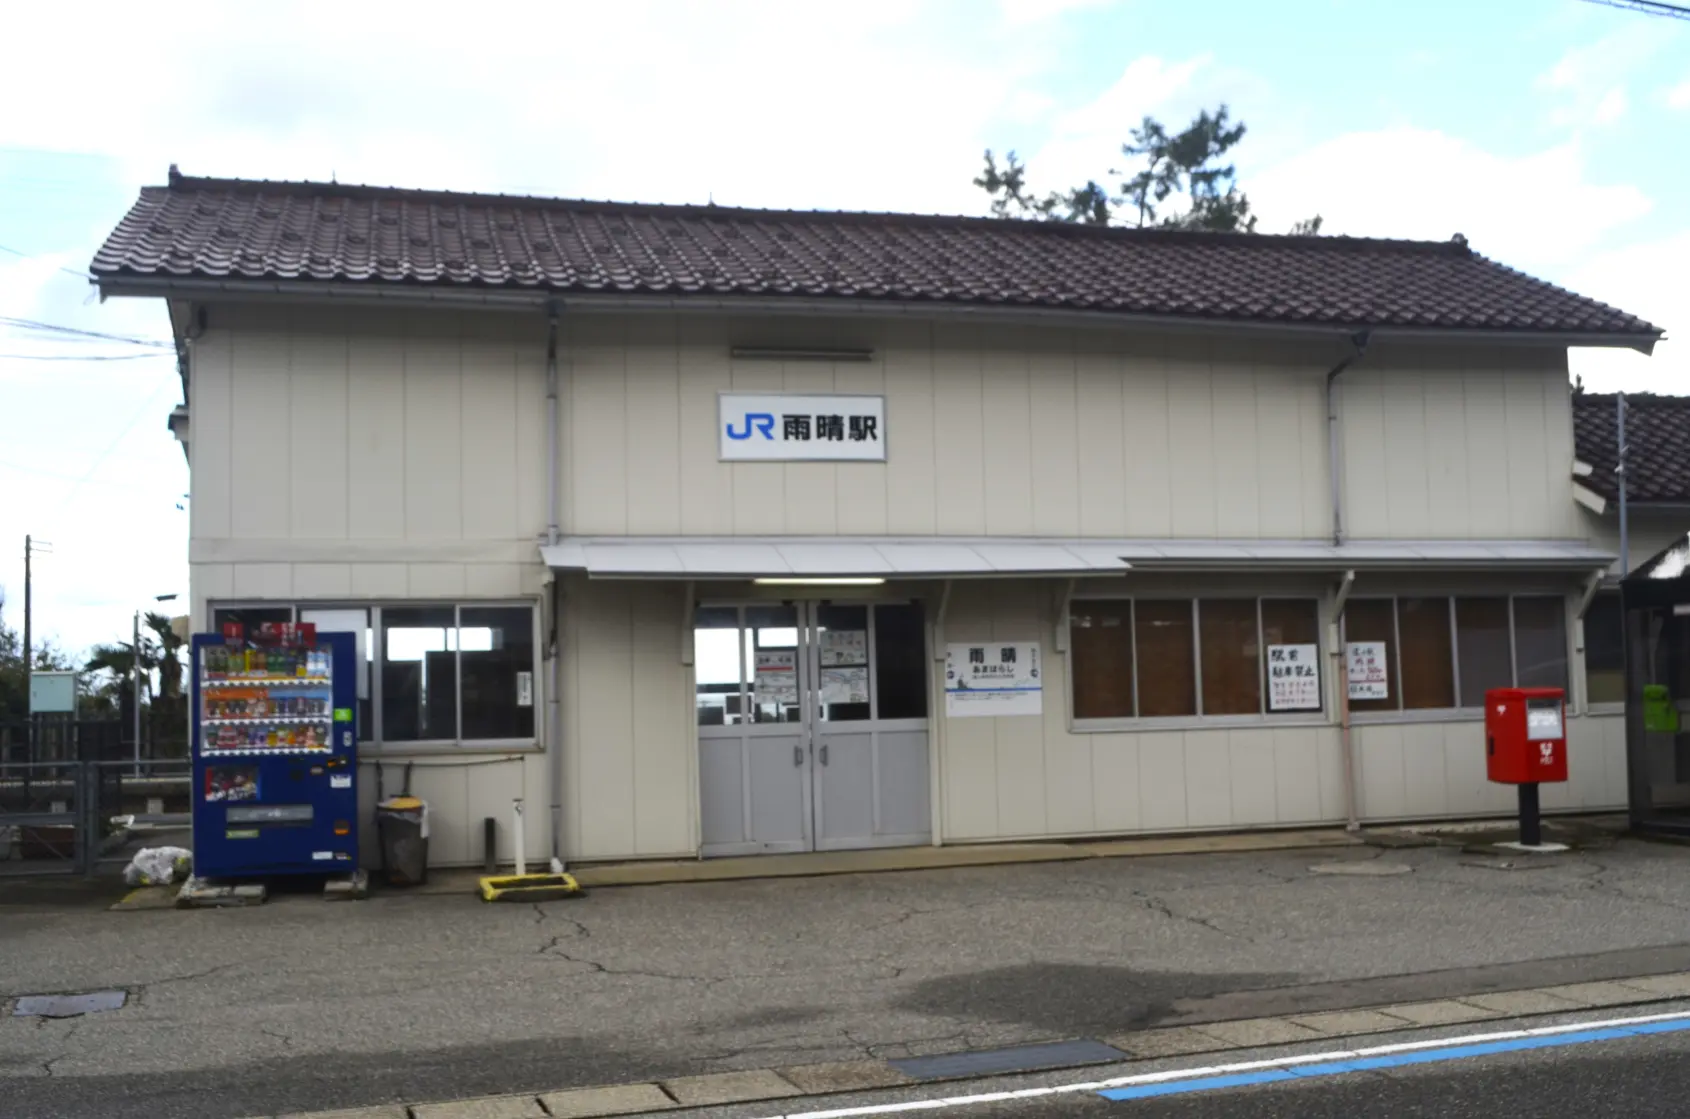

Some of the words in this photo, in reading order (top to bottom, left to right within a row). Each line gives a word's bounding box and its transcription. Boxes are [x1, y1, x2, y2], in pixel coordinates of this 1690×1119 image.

[726, 413, 775, 440] JR
[782, 413, 877, 441] 雨晴駅
